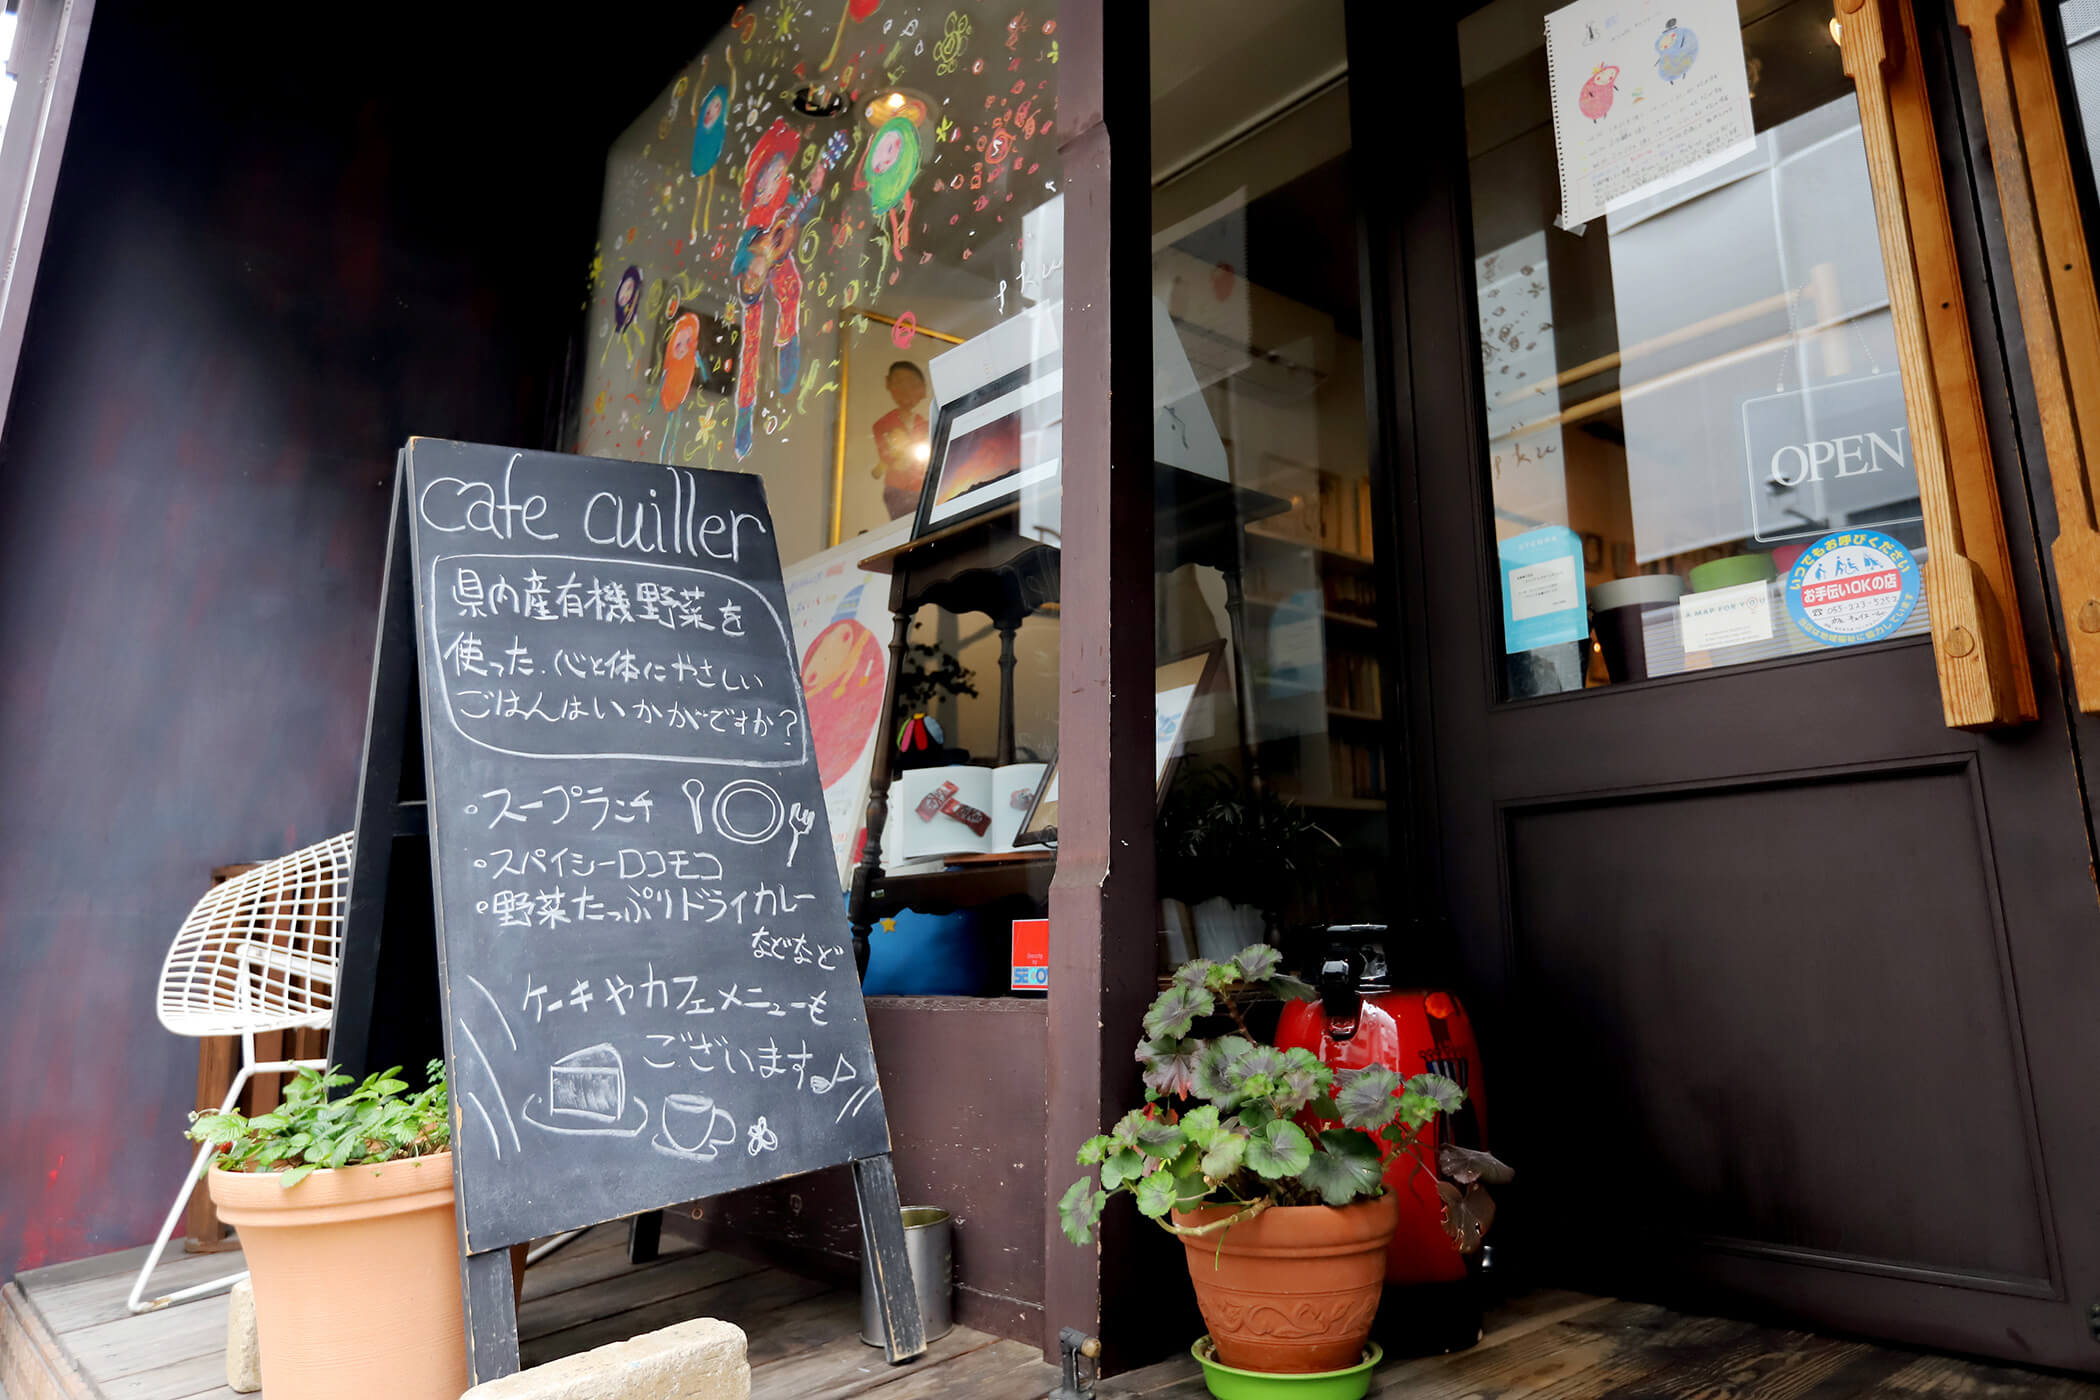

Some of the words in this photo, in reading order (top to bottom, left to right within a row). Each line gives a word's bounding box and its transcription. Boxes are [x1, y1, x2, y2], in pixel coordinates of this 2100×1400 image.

[1771, 427, 1906, 486] OPEN
[583, 467, 767, 562] cuiller
[1789, 533, 1911, 591] いつでもお呼びください
[1803, 573, 1898, 603] お手伝いOKの店
[451, 567, 747, 637] 県内産有機野菜を
[751, 926, 845, 970] などなど
[1014, 967, 1048, 984] SECO
